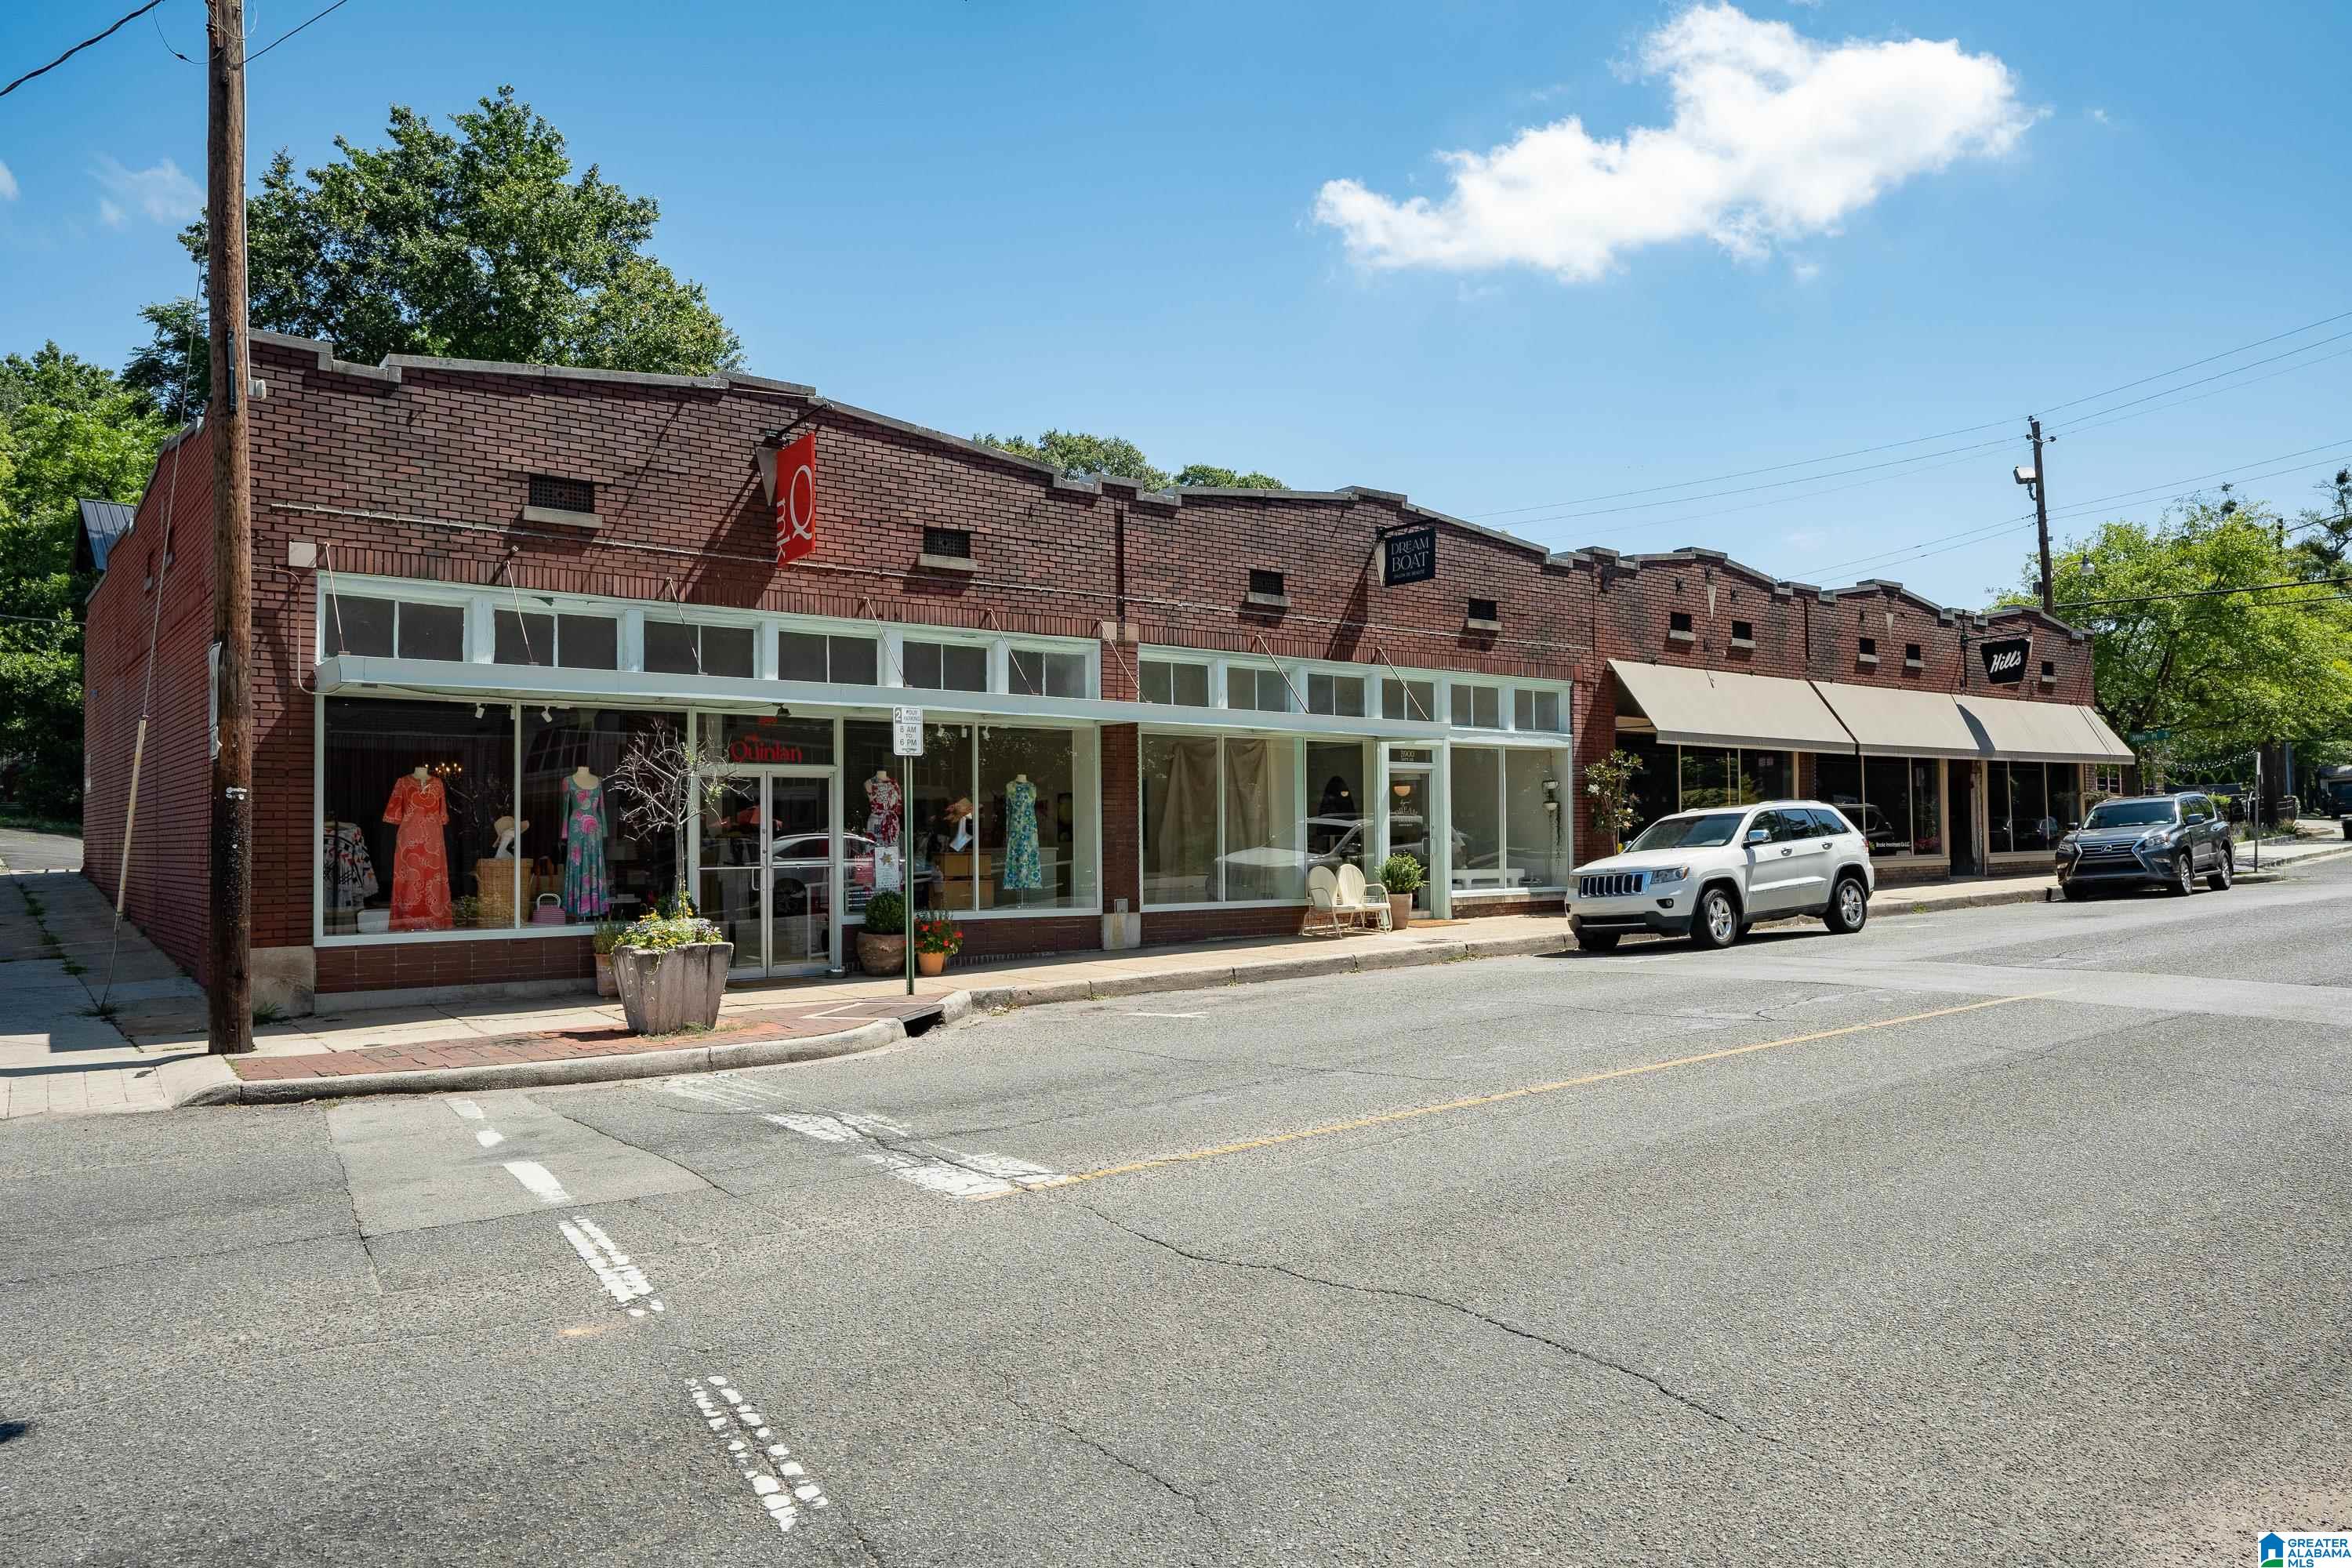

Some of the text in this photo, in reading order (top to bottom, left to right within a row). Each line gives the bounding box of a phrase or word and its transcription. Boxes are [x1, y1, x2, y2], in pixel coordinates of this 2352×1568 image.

[1391, 537, 1429, 555] DREAM
[1392, 551, 1429, 572] BOAT
[1990, 650, 2021, 673] Hill's
[895, 710, 902, 721] 2
[729, 740, 803, 764] Quinlan
